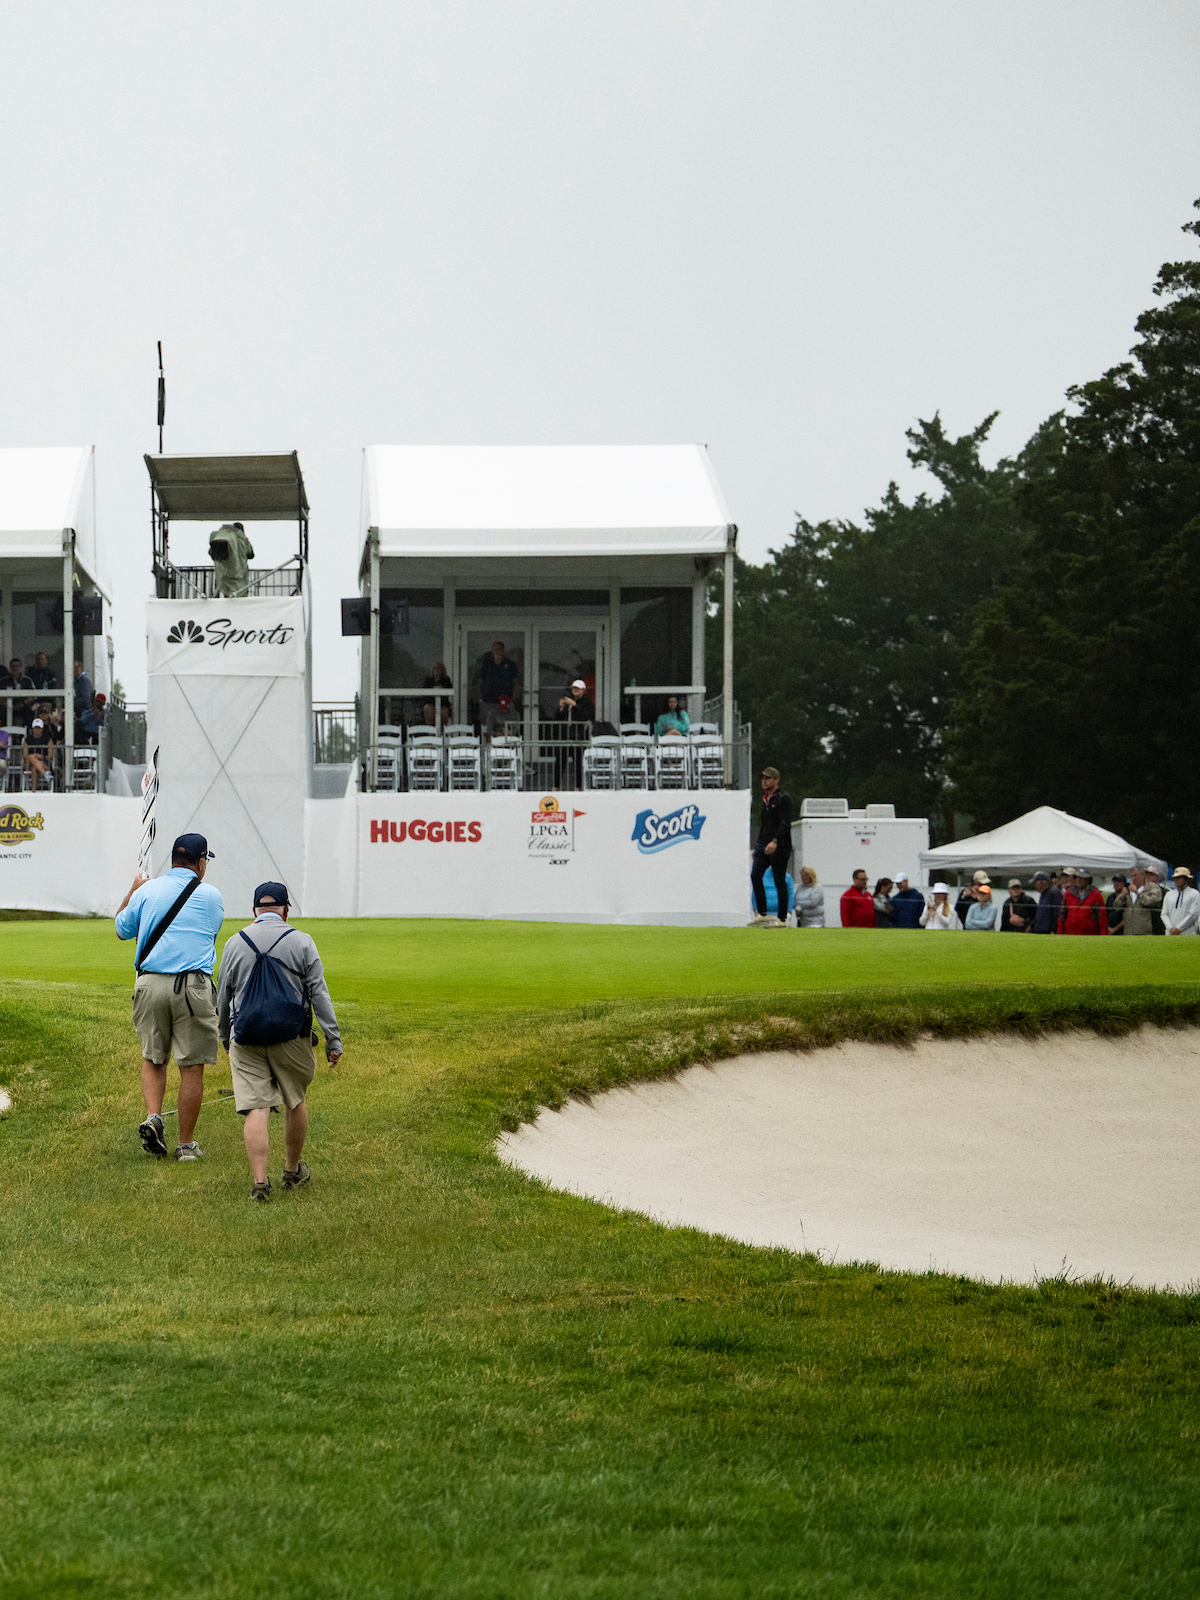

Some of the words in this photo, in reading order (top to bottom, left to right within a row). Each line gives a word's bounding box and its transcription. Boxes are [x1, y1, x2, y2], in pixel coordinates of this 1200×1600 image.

[205, 618, 294, 651] Sports
[10, 812, 45, 830] Rock
[370, 819, 483, 843] HUGGIES
[530, 825, 569, 836] LPGA
[641, 805, 697, 845] Scott
[528, 836, 571, 850] Classic
